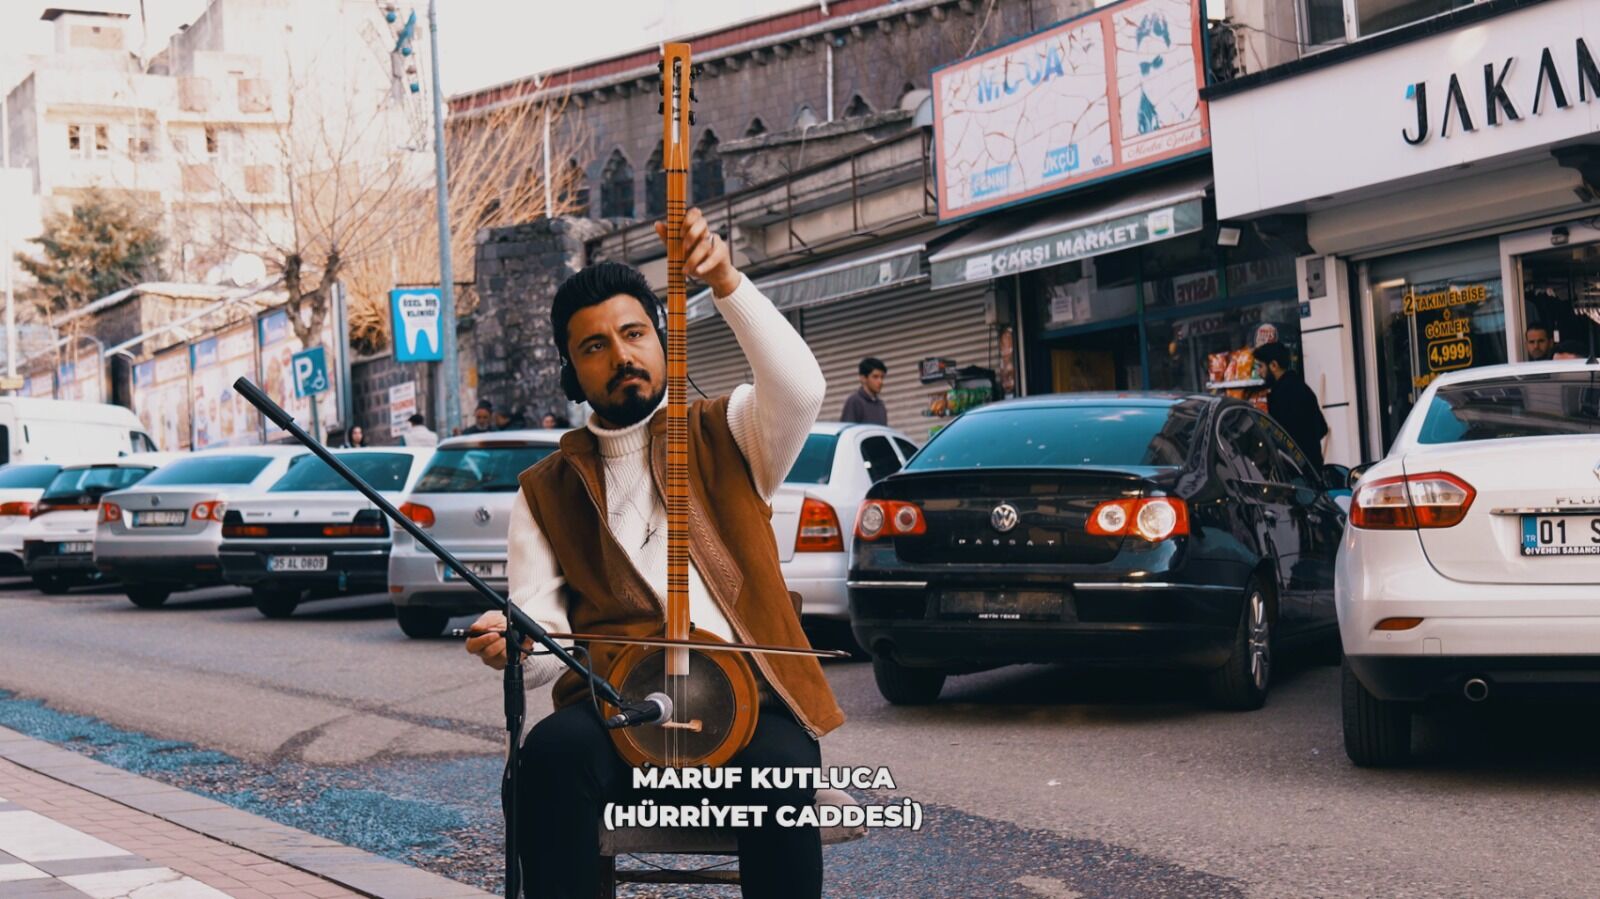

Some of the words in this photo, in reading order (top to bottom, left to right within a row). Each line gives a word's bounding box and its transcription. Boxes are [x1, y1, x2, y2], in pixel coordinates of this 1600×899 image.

[995, 244, 1050, 272] ÇARŞI
[1056, 223, 1139, 257] MARKET
[1415, 293, 1446, 312] TAKIM
[1448, 284, 1486, 306] ELBİSE
[1425, 318, 1470, 338] GÖMLEK
[294, 356, 313, 397] P
[958, 537, 1055, 546] PASSAT
[1540, 519, 1566, 545] 01
